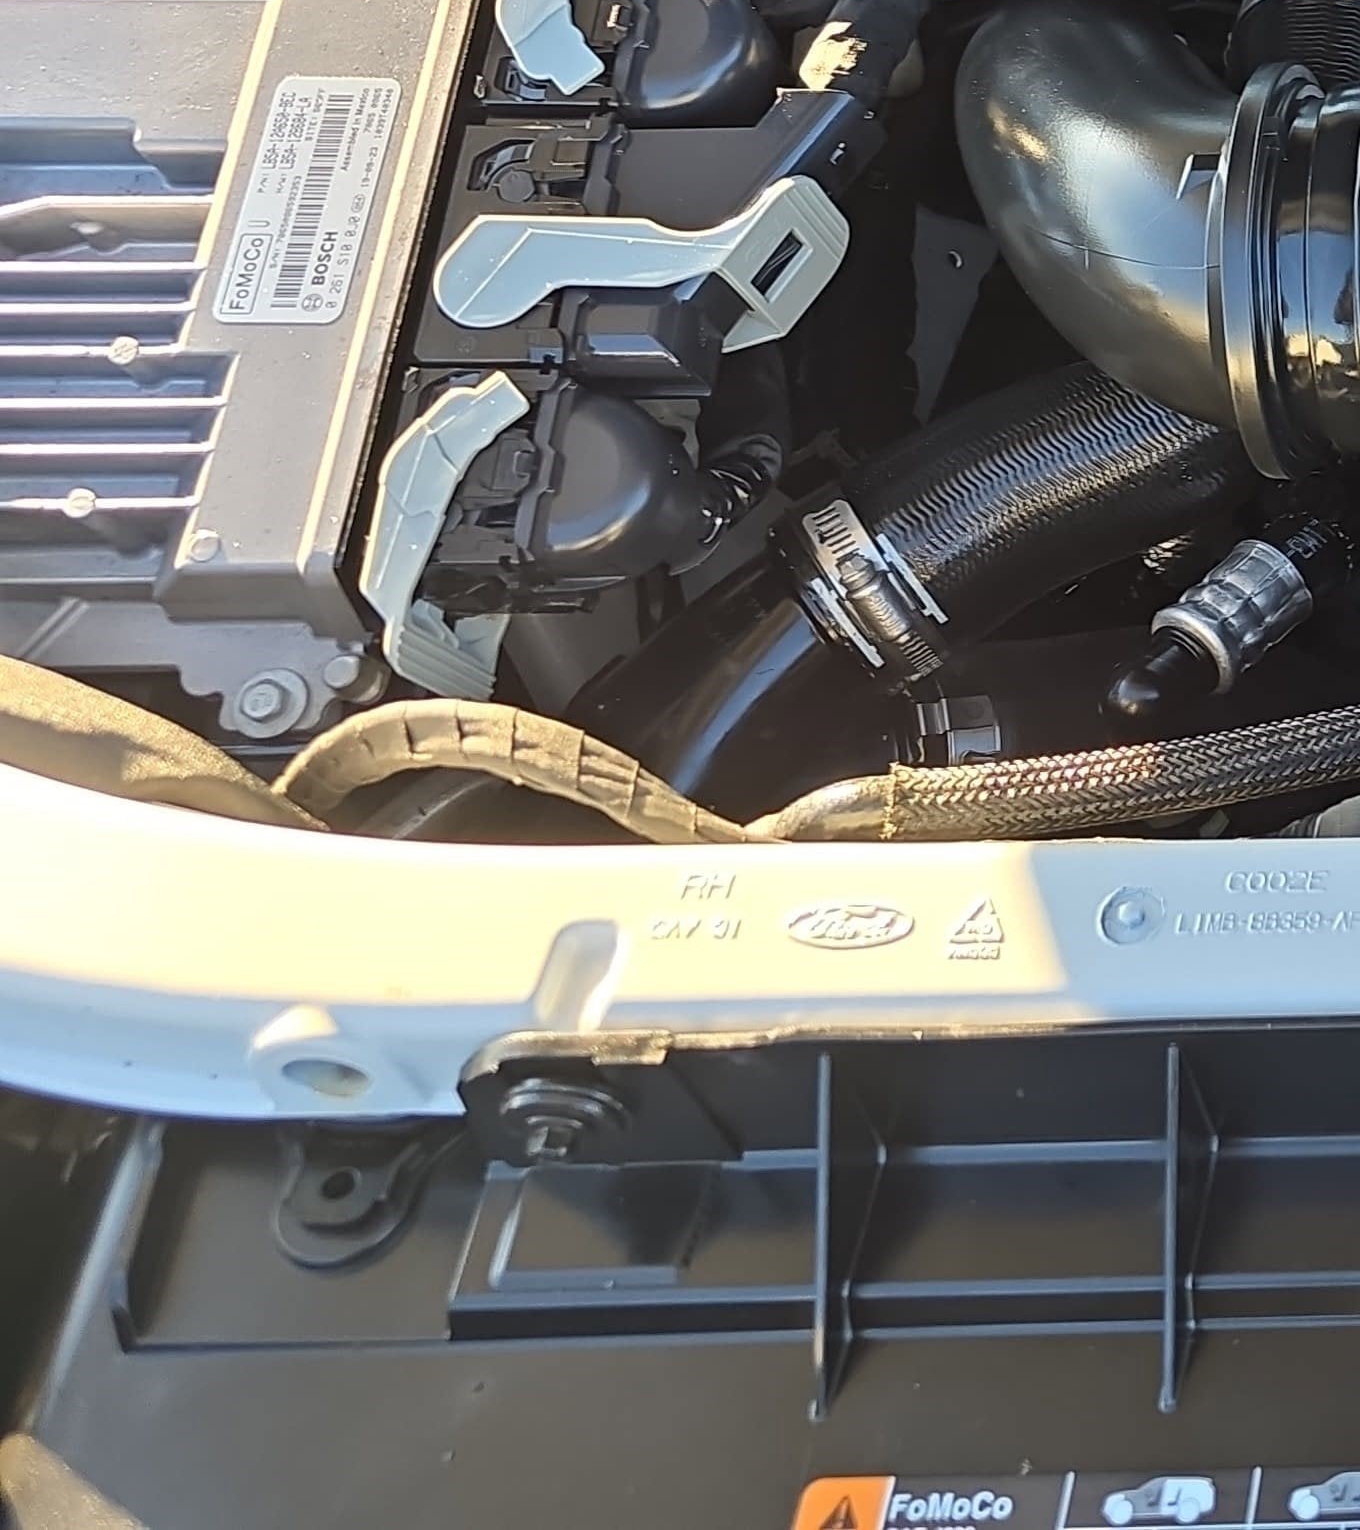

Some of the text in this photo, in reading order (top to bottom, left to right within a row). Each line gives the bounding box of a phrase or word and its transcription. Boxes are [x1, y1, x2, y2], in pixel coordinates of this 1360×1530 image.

[340, 127, 360, 171] Assembled
[355, 87, 370, 114] Mexico
[229, 237, 265, 310] FoMoCo
[310, 231, 338, 285] BOSCH
[330, 273, 345, 293] 261
[681, 874, 737, 900] RH
[808, 912, 896, 942] Ford
[887, 1490, 1014, 1523] FoMoCo
